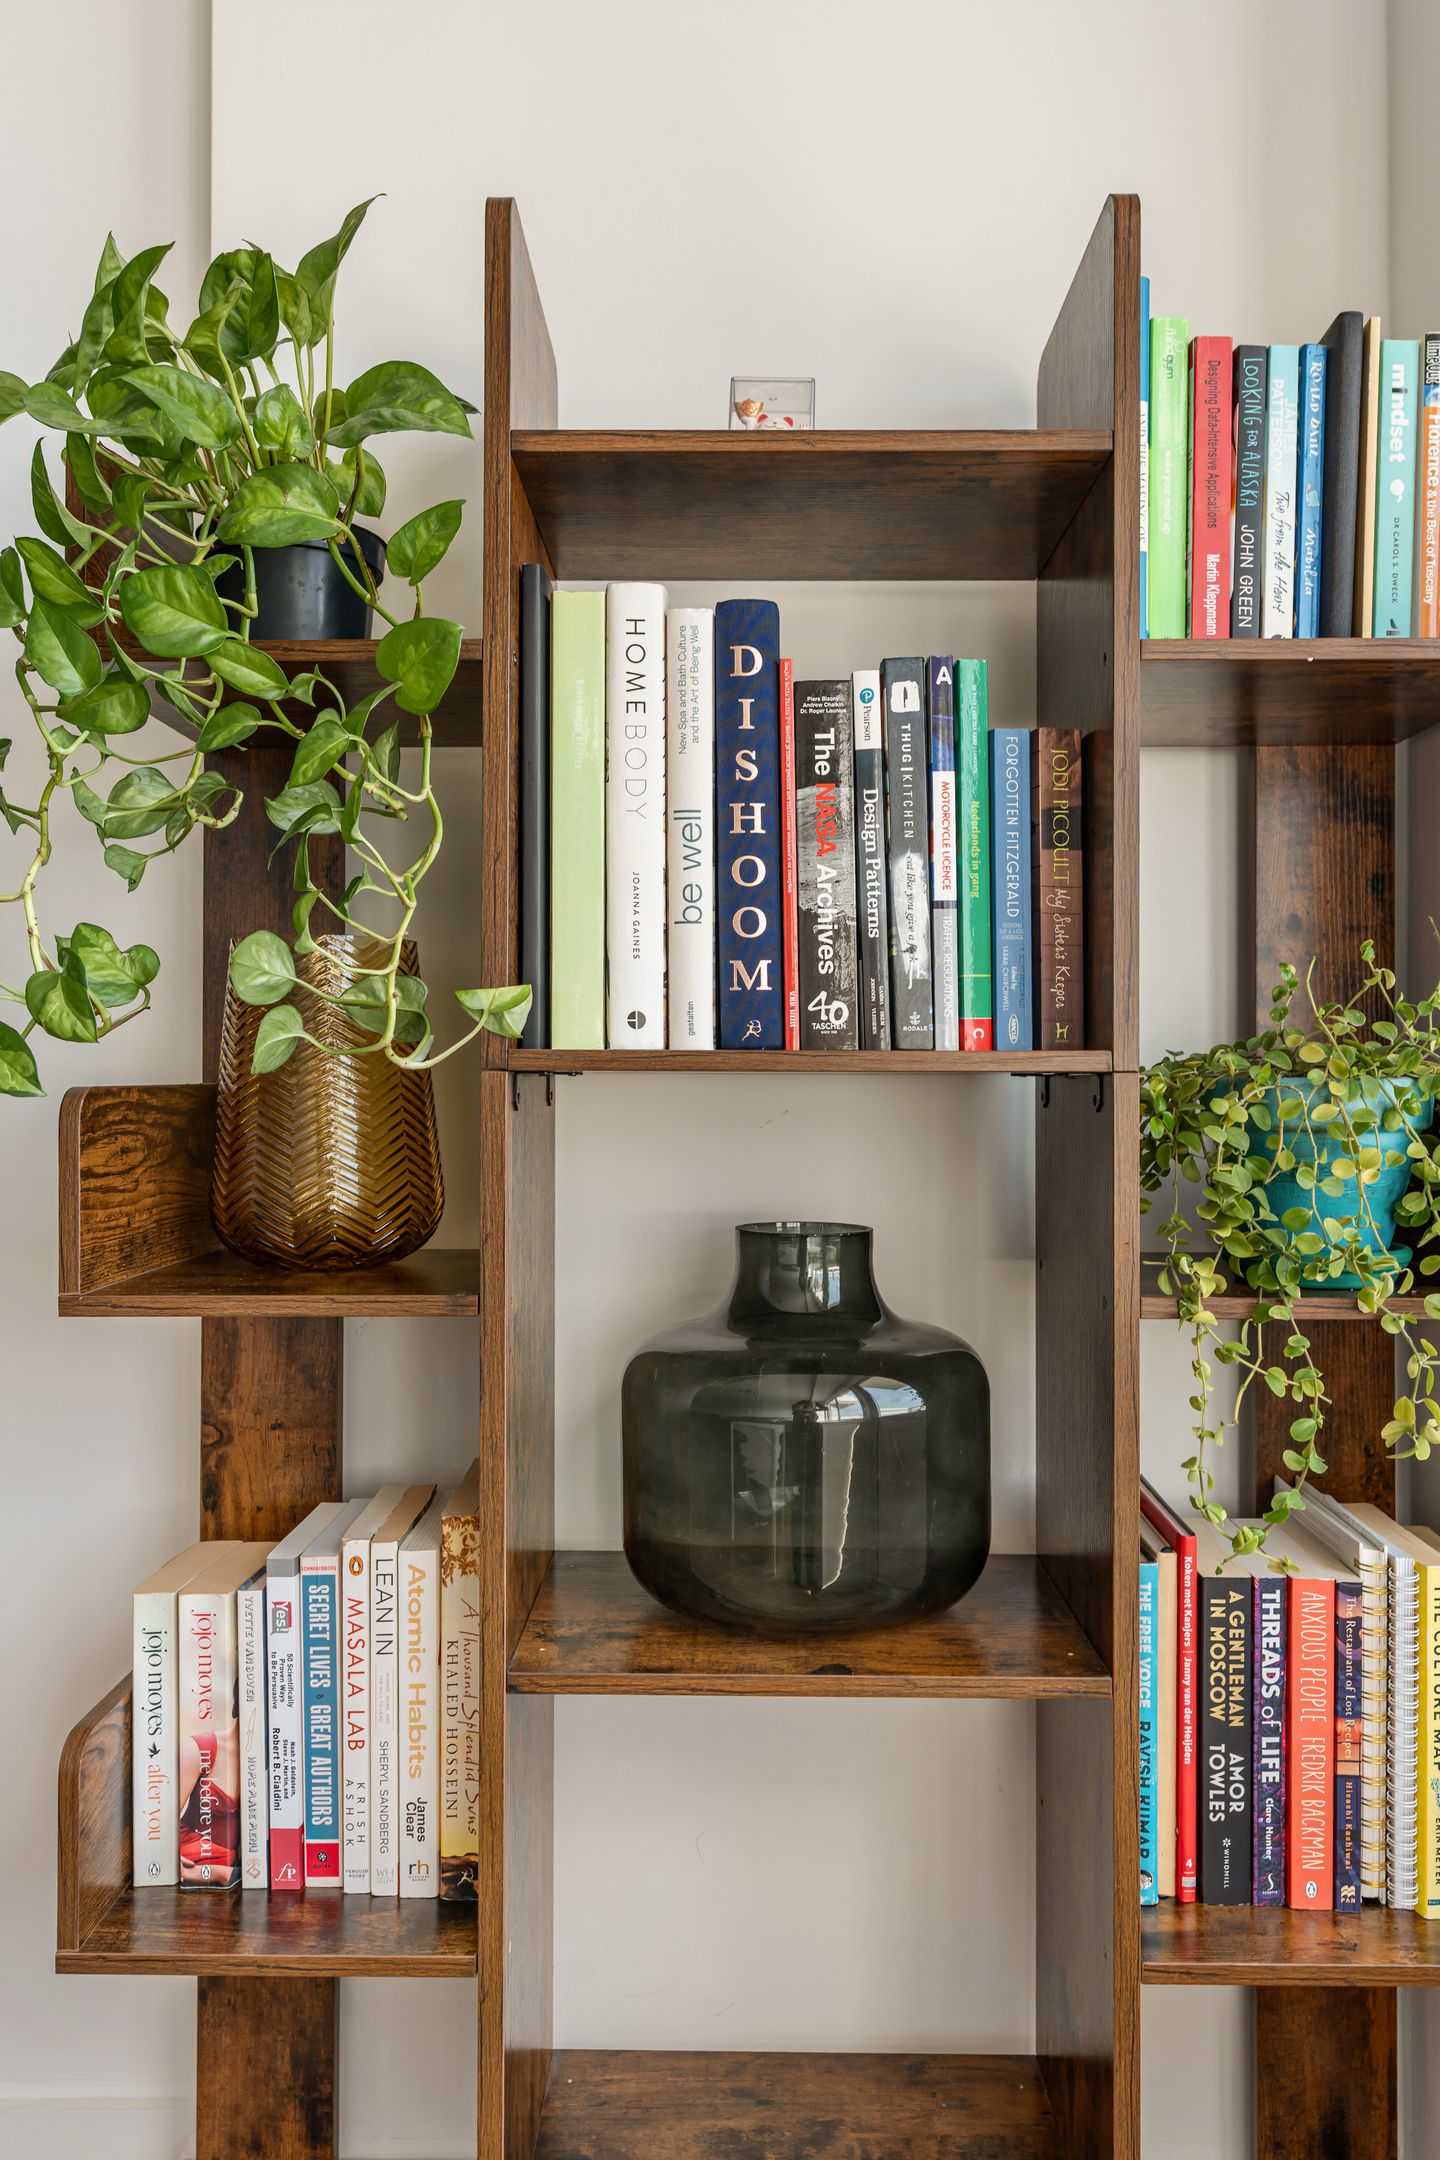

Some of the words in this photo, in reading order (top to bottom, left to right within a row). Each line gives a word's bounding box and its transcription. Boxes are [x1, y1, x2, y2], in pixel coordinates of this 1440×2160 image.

[1204, 360, 1221, 405] Designing
[1242, 358, 1264, 426] LOOKING
[1309, 361, 1323, 413] ROALD
[1389, 363, 1409, 463] mindset
[1207, 408, 1221, 471] Data-Intensive
[1247, 430, 1259, 447] FOR
[1308, 417, 1321, 458] DAHL
[1427, 414, 1440, 486] Florence
[1239, 452, 1262, 507] ALASKA
[1204, 473, 1220, 529] Applications
[1273, 490, 1291, 514] Two
[1426, 500, 1437, 517] the
[1271, 513, 1291, 546] from
[1393, 517, 1400, 529] DR
[1426, 519, 1437, 545] Best
[1240, 524, 1255, 568] JOHN
[1273, 552, 1291, 571] the
[1304, 528, 1318, 596] Matilda
[1392, 531, 1400, 560] CAROL
[1426, 546, 1437, 558] of
[1206, 554, 1220, 583] Martin
[1391, 573, 1399, 603] DWECK
[1423, 560, 1436, 605] Tuscany
[1203, 584, 1220, 636] Kleppmann
[1238, 575, 1254, 628] GREEN
[1271, 576, 1288, 615] Heart
[677, 625, 687, 662] Culture
[690, 624, 699, 643] Well
[677, 663, 687, 687] Bath
[690, 645, 701, 674] Being
[677, 689, 687, 708] and
[690, 675, 699, 686] of
[690, 688, 699, 704] Art
[624, 618, 647, 820] HOMEBODY
[677, 711, 689, 731] Spa
[690, 706, 699, 723] the
[690, 725, 699, 744] and
[863, 705, 872, 742] Pearson
[677, 732, 687, 755] New
[814, 727, 836, 777] The
[900, 723, 912, 762] THUG
[1005, 736, 1019, 825] FORGOTTEN
[1051, 749, 1069, 791] JODI
[729, 644, 772, 991] DISHOOM
[815, 783, 837, 857] NASA
[860, 787, 880, 853] Design
[902, 774, 914, 838] KITCHEN
[941, 781, 951, 850] MOTORCYCLE
[674, 810, 703, 871] well
[971, 800, 981, 858] Nederlands
[1052, 800, 1070, 885] PICOULT
[905, 856, 914, 870] eat
[906, 873, 916, 891] like
[942, 852, 952, 890] LICENCE
[972, 860, 982, 872] in
[1006, 831, 1020, 918] FITZGERALD
[631, 871, 641, 917] JOANNA
[674, 883, 703, 925] be
[865, 857, 882, 939] Patterns
[904, 891, 914, 910] you
[969, 873, 980, 898] gang
[1046, 888, 1071, 909] My
[816, 863, 838, 975] Archives
[904, 913, 917, 932] give
[942, 915, 953, 952] TRAFFIC
[1052, 913, 1071, 960] Sister's
[631, 920, 641, 960] GAINES
[942, 953, 953, 1018] REGULATIONS
[1050, 964, 1071, 1010] Keeper
[686, 1000, 697, 1036] gestalten
[807, 990, 850, 1025] 40
[811, 1022, 847, 1030] TASCHEN
[375, 1558, 394, 1623] LEAN
[1183, 1556, 1193, 1587] Koken
[275, 1601, 290, 1633] Yes!
[308, 1584, 330, 1640] SECRET
[460, 1598, 480, 1619] A
[1139, 1581, 1151, 1612] THE
[1183, 1588, 1193, 1608] met
[1209, 1598, 1226, 1618] IN
[1229, 1590, 1245, 1604] A
[1346, 1597, 1357, 1617] The
[191, 1609, 217, 1650] jojo
[407, 1563, 426, 1674] Atomic
[1139, 1616, 1151, 1653] FREE
[1181, 1610, 1193, 1647] Kanjers
[1300, 1591, 1327, 1662] ANXIOUS
[141, 1627, 168, 1668] jojo
[271, 1651, 278, 1659] to
[286, 1653, 294, 1662] 50
[347, 1597, 366, 1698] MASALA
[375, 1633, 394, 1655] IN
[459, 1622, 480, 1699] Thousand
[1261, 1589, 1281, 1699] THREADS
[1345, 1620, 1356, 1677] Restaurant
[271, 1660, 278, 1670] Be
[286, 1663, 294, 1708] Scientifically
[309, 1646, 331, 1688] LIVES
[447, 1640, 459, 1717] KHALED
[1139, 1657, 1152, 1708] VOICE
[1181, 1656, 1193, 1686] Janny
[1209, 1626, 1227, 1722] MOSCOW
[1228, 1610, 1245, 1727] GENTLEMAN
[1345, 1678, 1356, 1692] of
[141, 1672, 163, 1737] moyes
[191, 1655, 213, 1720] moyes
[1183, 1687, 1192, 1706] van
[1300, 1667, 1327, 1723] PEOPLE
[1345, 1695, 1355, 1716] Lost
[310, 1704, 332, 1750] GREAT
[347, 1710, 366, 1751] LAB
[408, 1683, 427, 1780] Habits
[1183, 1707, 1193, 1725] der
[272, 1728, 281, 1760] Robert
[458, 1702, 480, 1782] Splendid
[1181, 1726, 1193, 1765] Heijden
[1261, 1736, 1280, 1783] LIFE
[1342, 1719, 1355, 1759] Recipes
[199, 1749, 212, 1775] me
[273, 1762, 281, 1772] B.
[379, 1741, 389, 1786] SHERYL
[446, 1728, 458, 1819] HOSSEINI
[1229, 1752, 1245, 1813] AMOR
[1300, 1737, 1326, 1794] FREDRIK
[147, 1764, 170, 1804] after
[199, 1778, 219, 1825] before
[273, 1774, 282, 1811] Cialdini
[311, 1756, 333, 1826] AUTHORS
[1209, 1744, 1226, 1822] TOWLES
[1345, 1782, 1353, 1820] Hisashi
[143, 1811, 161, 1841] you
[345, 1779, 354, 1846] ASHOK
[357, 1782, 366, 1843] KRISH
[379, 1789, 389, 1854] SANDBERG
[405, 1802, 417, 1838] Clear
[417, 1797, 428, 1842] James
[464, 1788, 480, 1836] Suns
[1265, 1797, 1274, 1824] Clare
[195, 1829, 212, 1857] you
[1264, 1826, 1274, 1860] Hunter
[1300, 1800, 1326, 1870] BACKMAN
[1345, 1824, 1353, 1870] Kashiwai
